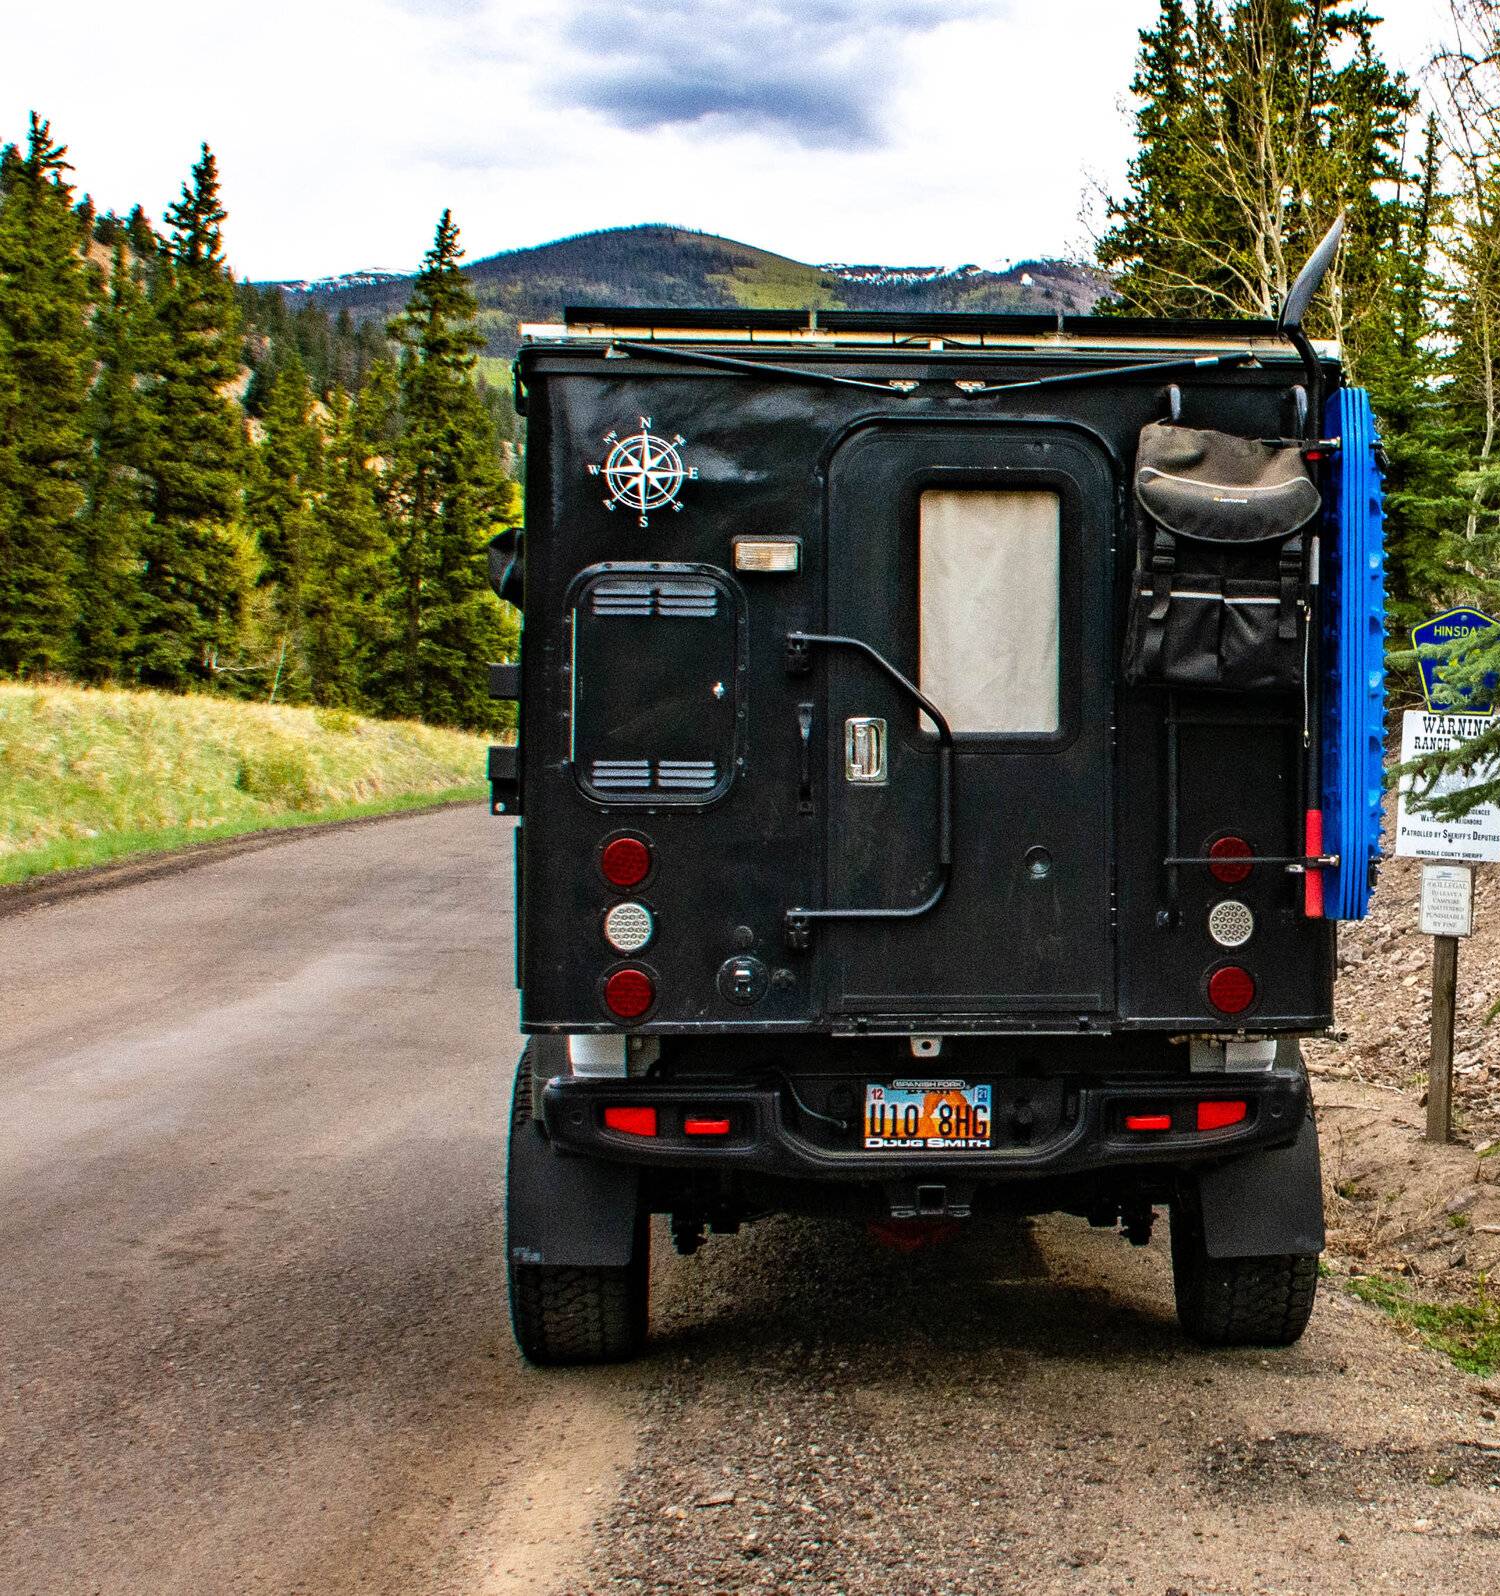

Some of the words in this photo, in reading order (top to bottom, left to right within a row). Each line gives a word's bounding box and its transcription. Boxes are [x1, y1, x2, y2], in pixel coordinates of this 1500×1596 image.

[640, 416, 652, 429] N
[587, 464, 601, 476] W
[688, 467, 699, 479] E
[640, 516, 649, 528] S
[1434, 625, 1480, 637] HINSDA
[1414, 737, 1450, 750] RANCH
[1402, 827, 1433, 838] PATROLLED
[1473, 831, 1500, 842] DEPUTIES
[871, 1088, 883, 1100] 12
[978, 1089, 987, 1099] 21
[869, 1103, 919, 1137] U10
[938, 1103, 988, 1137] 8HG
[865, 1138, 924, 1148] DOUG
[927, 1138, 990, 1148] SMITH
